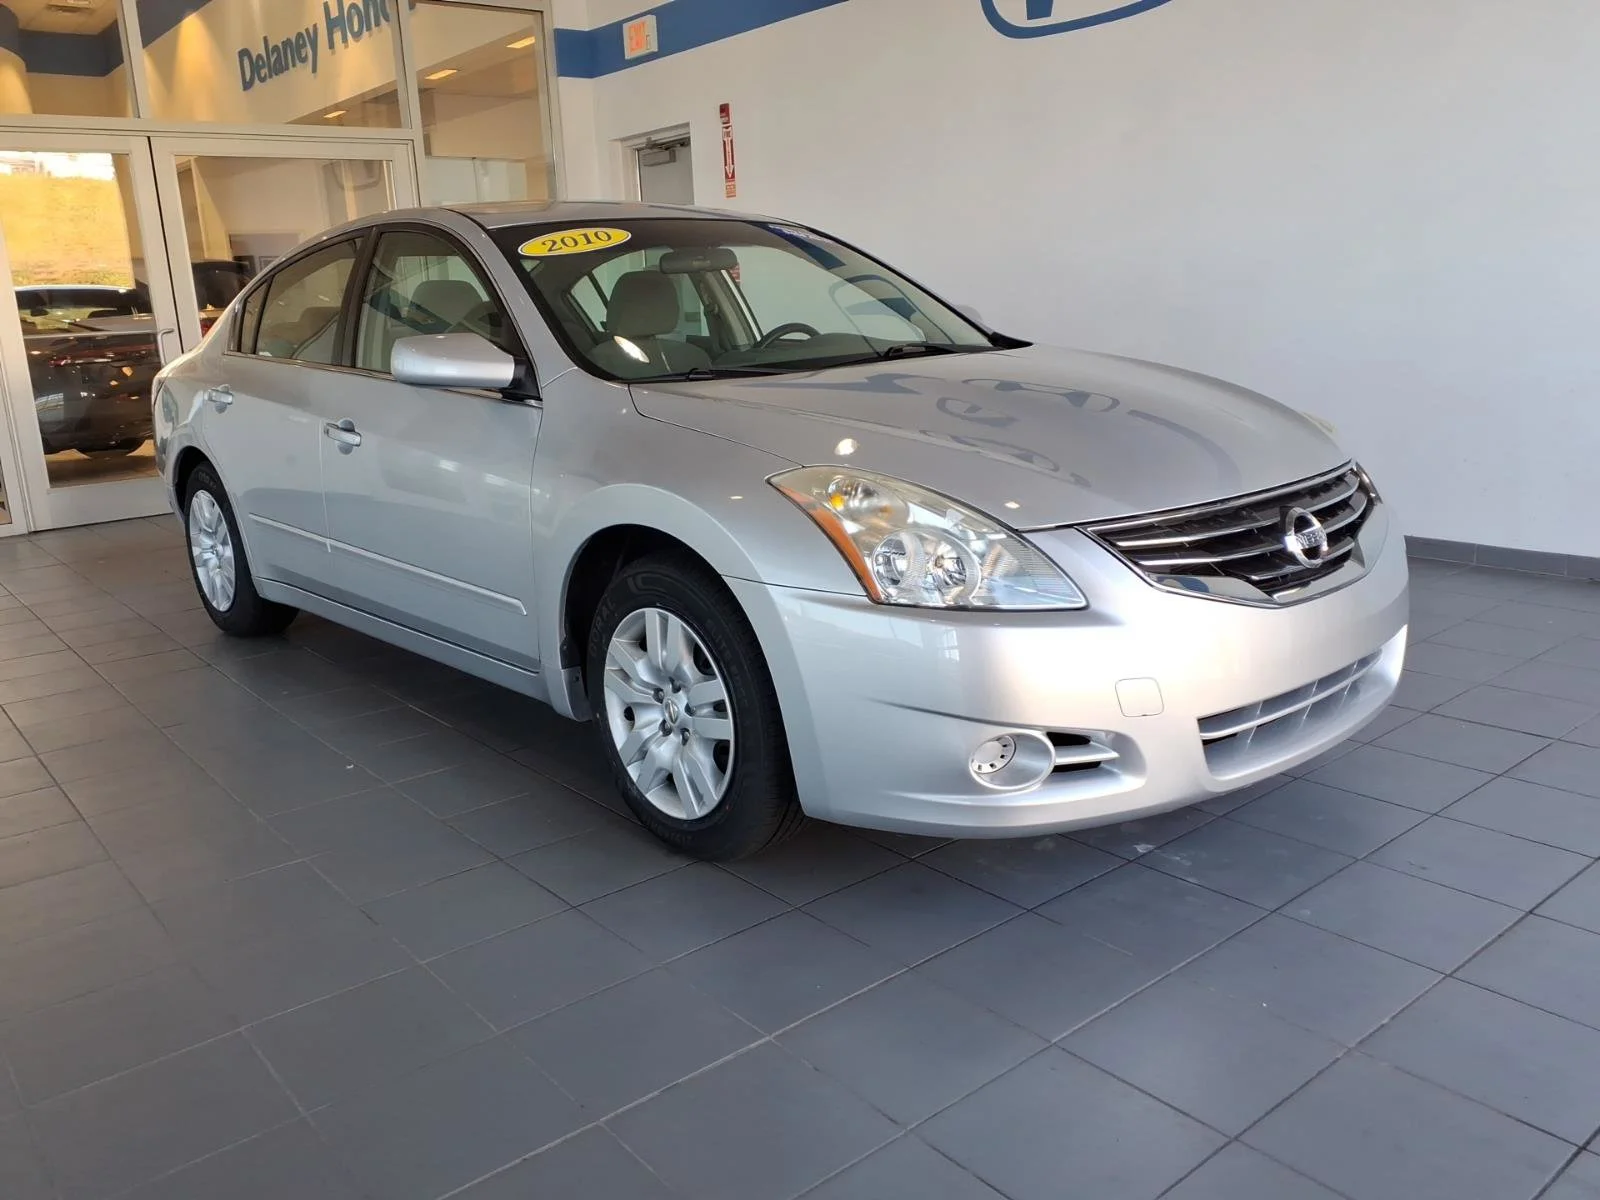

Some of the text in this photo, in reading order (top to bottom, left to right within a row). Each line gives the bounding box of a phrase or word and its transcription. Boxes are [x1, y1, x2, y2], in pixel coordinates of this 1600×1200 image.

[238, 0, 392, 91] Delaney Hon
[541, 230, 612, 252] 2010
